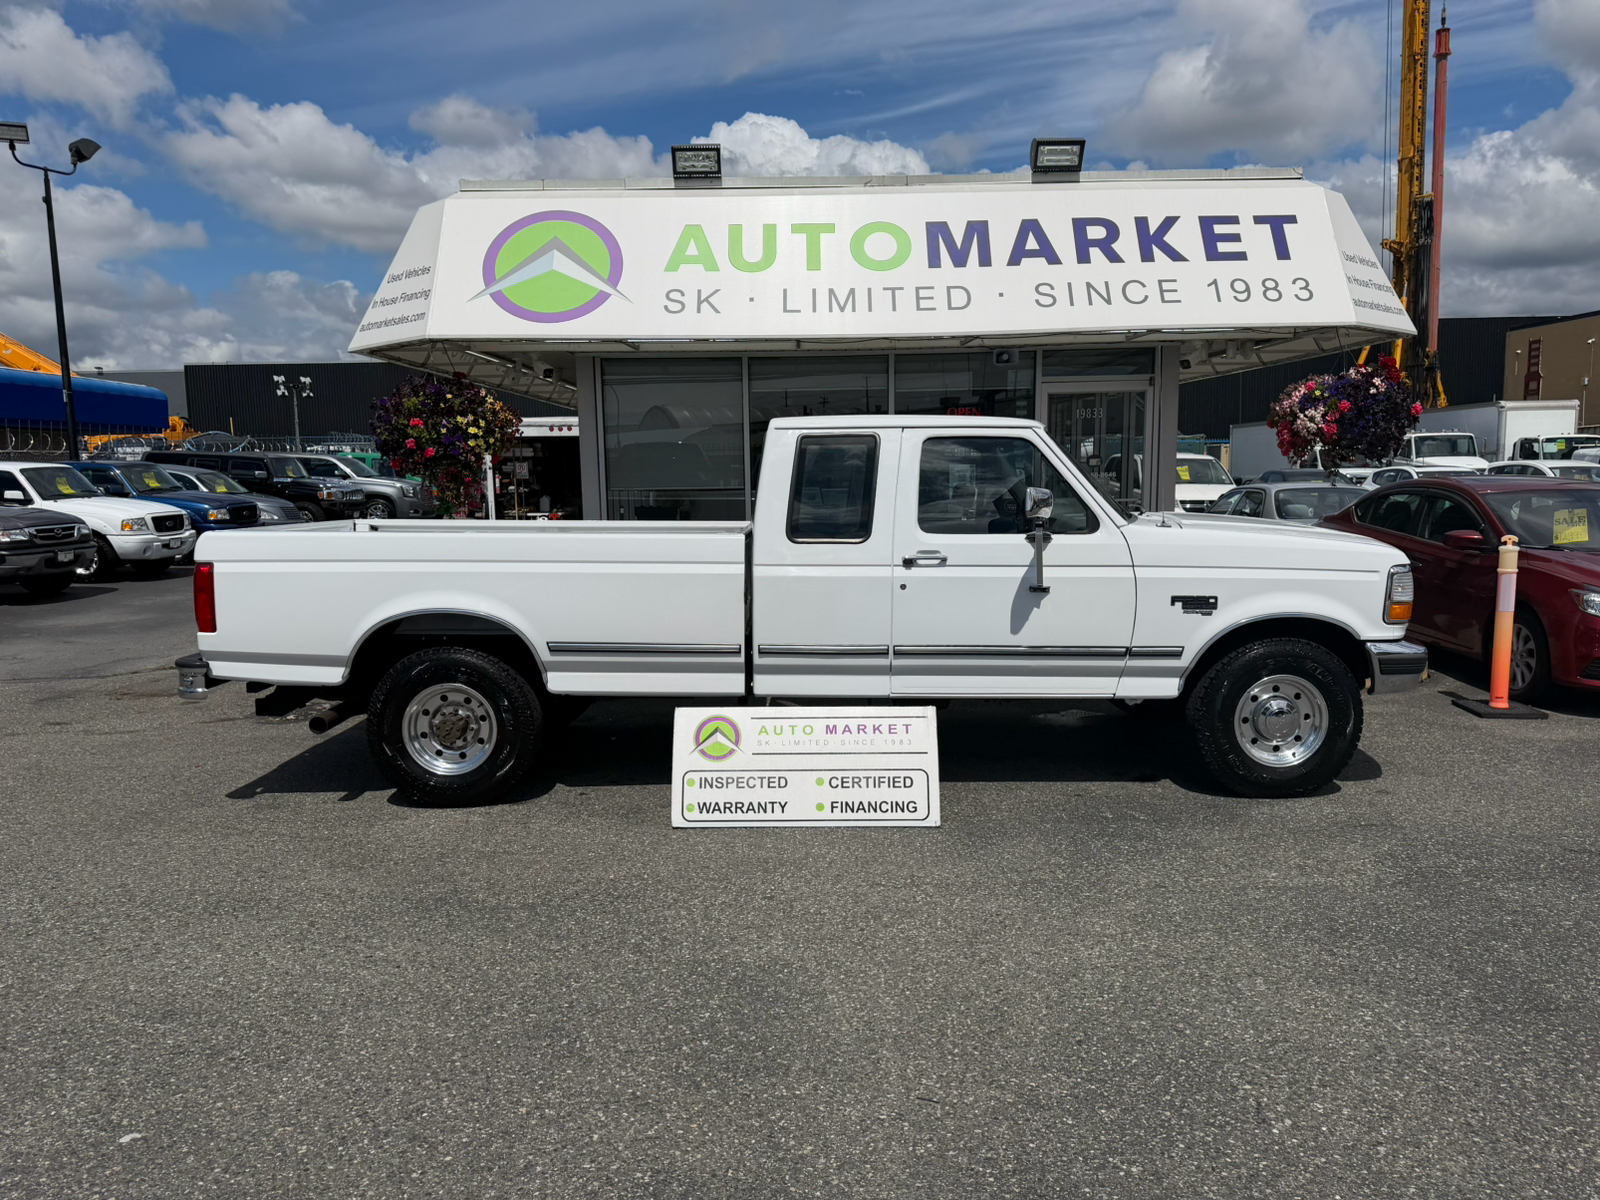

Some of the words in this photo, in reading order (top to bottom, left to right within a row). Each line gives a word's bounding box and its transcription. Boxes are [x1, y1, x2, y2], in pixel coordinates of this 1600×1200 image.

[1341, 250, 1358, 264] Used
[1356, 254, 1379, 269] Vehicles
[387, 270, 405, 284] Used
[404, 265, 431, 279] Vehicles
[1345, 273, 1353, 284] In
[1351, 274, 1371, 289] House
[1368, 279, 1395, 296] Financing
[371, 299, 379, 309] In
[378, 296, 398, 308] House
[398, 288, 431, 303] Financing
[664, 288, 722, 314] SK
[783, 286, 972, 314] LIMITED
[1035, 278, 1183, 308] SINCE
[1207, 277, 1313, 303] 1983
[1352, 298, 1406, 316] automarketsales.com
[359, 312, 426, 332] automarketsales.com
[1076, 407, 1104, 419] 19833
[1554, 515, 1586, 526] SALE
[758, 725, 815, 736] AUTO
[825, 724, 912, 735] MARKET
[699, 776, 788, 789] INSPECTED
[828, 776, 914, 789] CERTIFIED
[697, 801, 788, 814] WARRANTY
[831, 801, 918, 814] FINANCING
